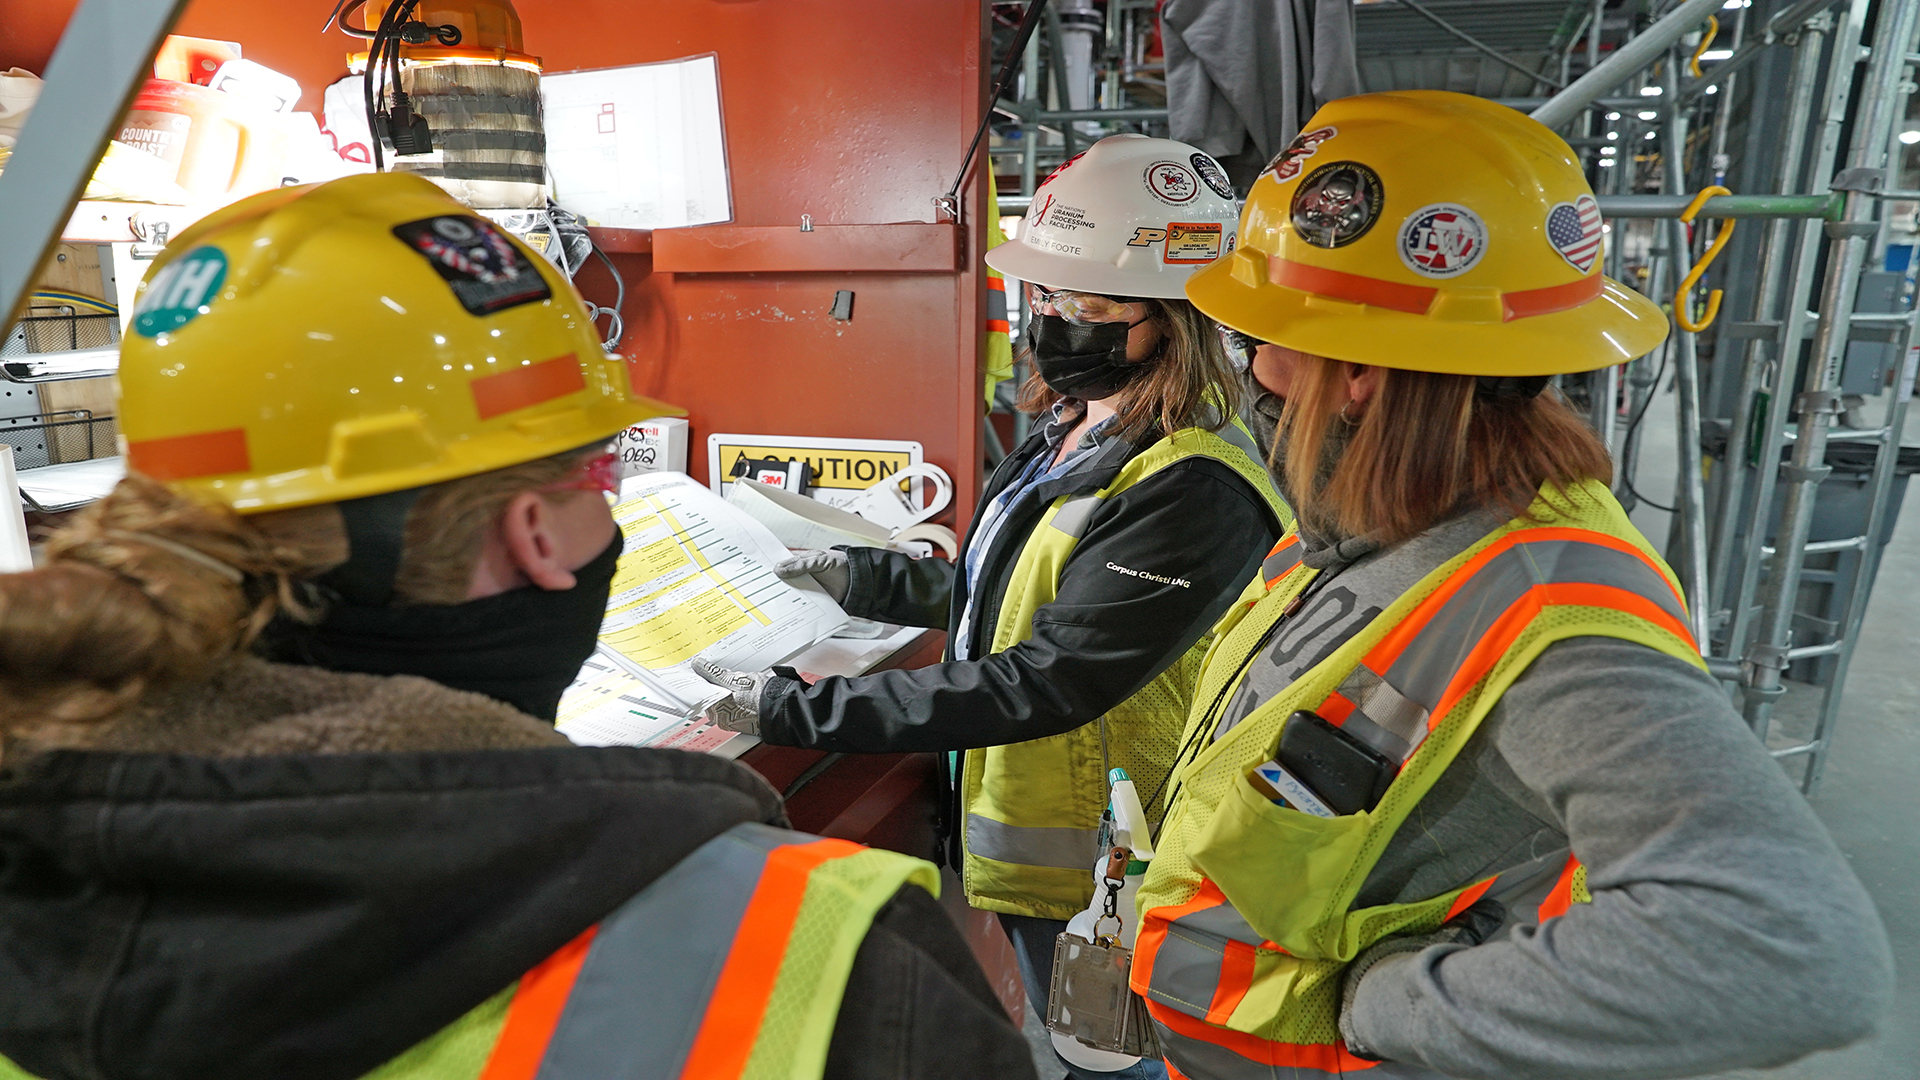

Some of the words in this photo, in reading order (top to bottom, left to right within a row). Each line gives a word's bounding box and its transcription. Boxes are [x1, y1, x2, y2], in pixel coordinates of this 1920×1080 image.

[1051, 214, 1096, 229] PROCESSING
[1053, 208, 1085, 220] URANIUM
[1048, 220, 1078, 232] FACILITY
[1031, 236, 1050, 248] EMILY
[1051, 242, 1082, 256] FOOTE
[1410, 227, 1473, 257] IW
[761, 475, 782, 485] 3M
[1105, 561, 1138, 577] Corpus
[1138, 571, 1172, 585] Christi
[1171, 577, 1192, 589] LNG
